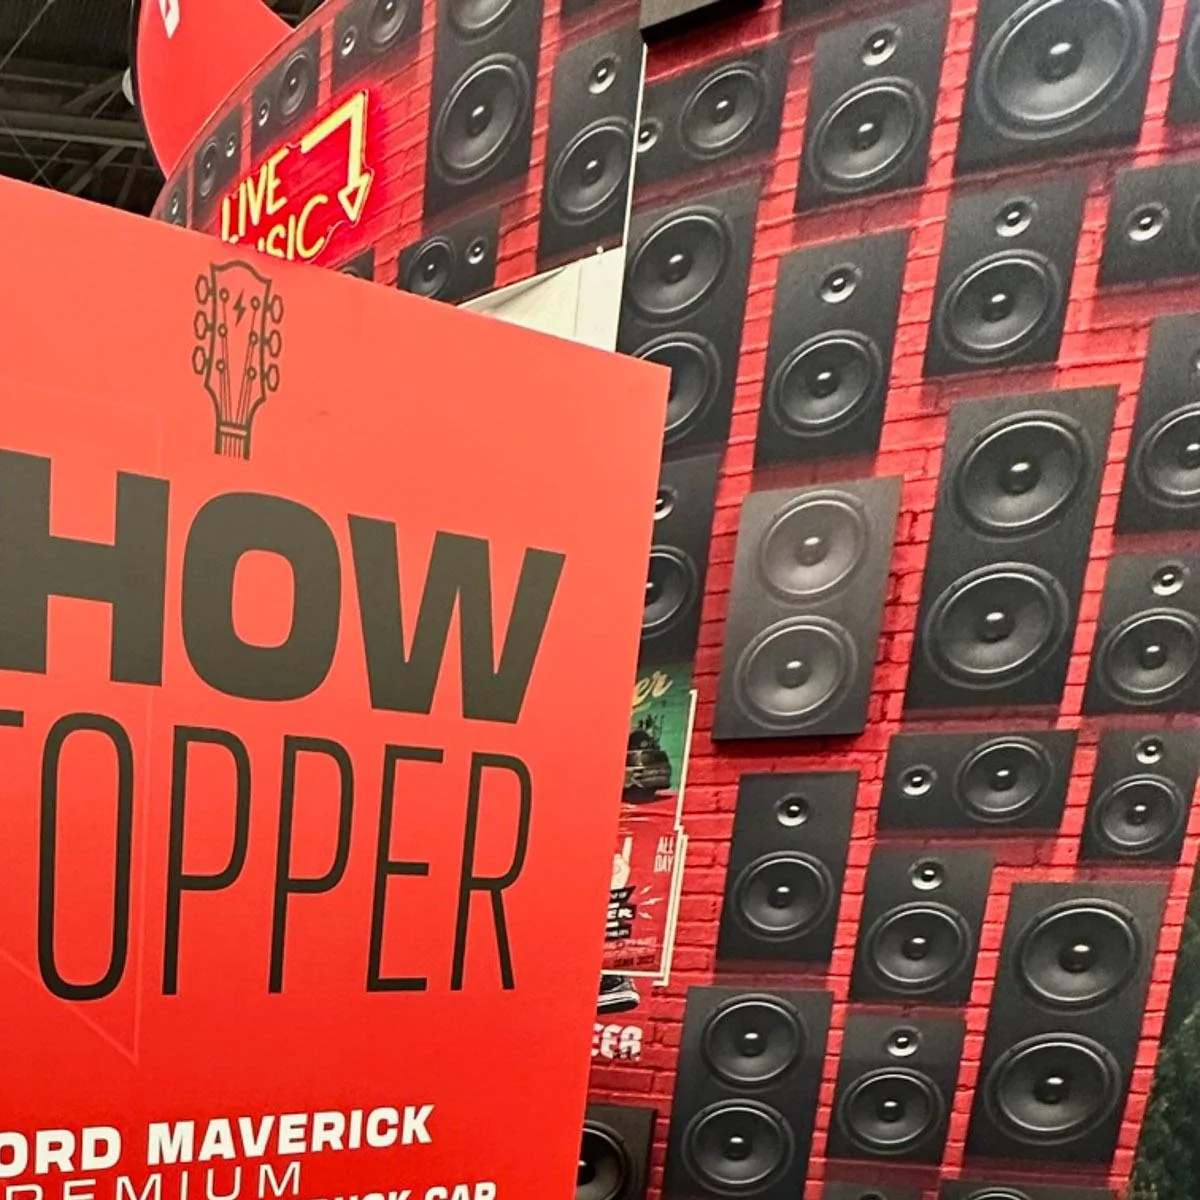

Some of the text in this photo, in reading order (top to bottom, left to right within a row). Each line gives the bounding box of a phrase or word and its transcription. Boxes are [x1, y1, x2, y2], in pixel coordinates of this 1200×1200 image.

[222, 148, 290, 244] LIVE
[258, 194, 328, 260] SIC
[147, 1104, 435, 1166] MAVERICK
